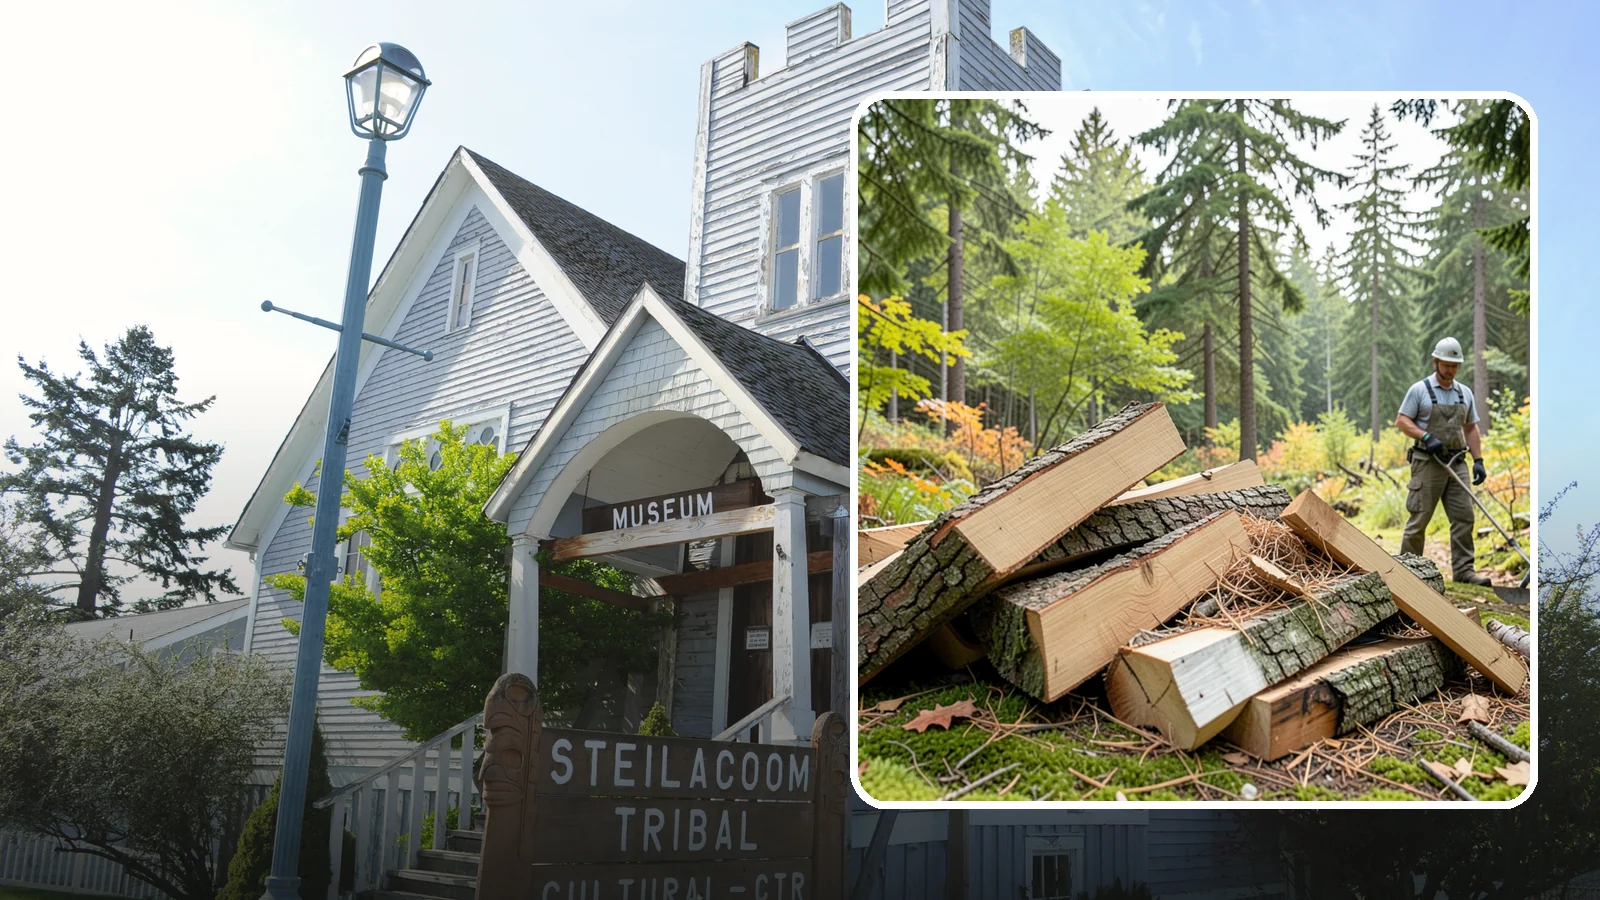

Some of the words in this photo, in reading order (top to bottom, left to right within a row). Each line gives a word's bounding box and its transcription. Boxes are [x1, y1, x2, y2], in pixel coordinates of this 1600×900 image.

[613, 491, 714, 531] MUSEUM
[550, 738, 809, 793] STEILACOOM
[615, 807, 758, 852] TRIBAL
